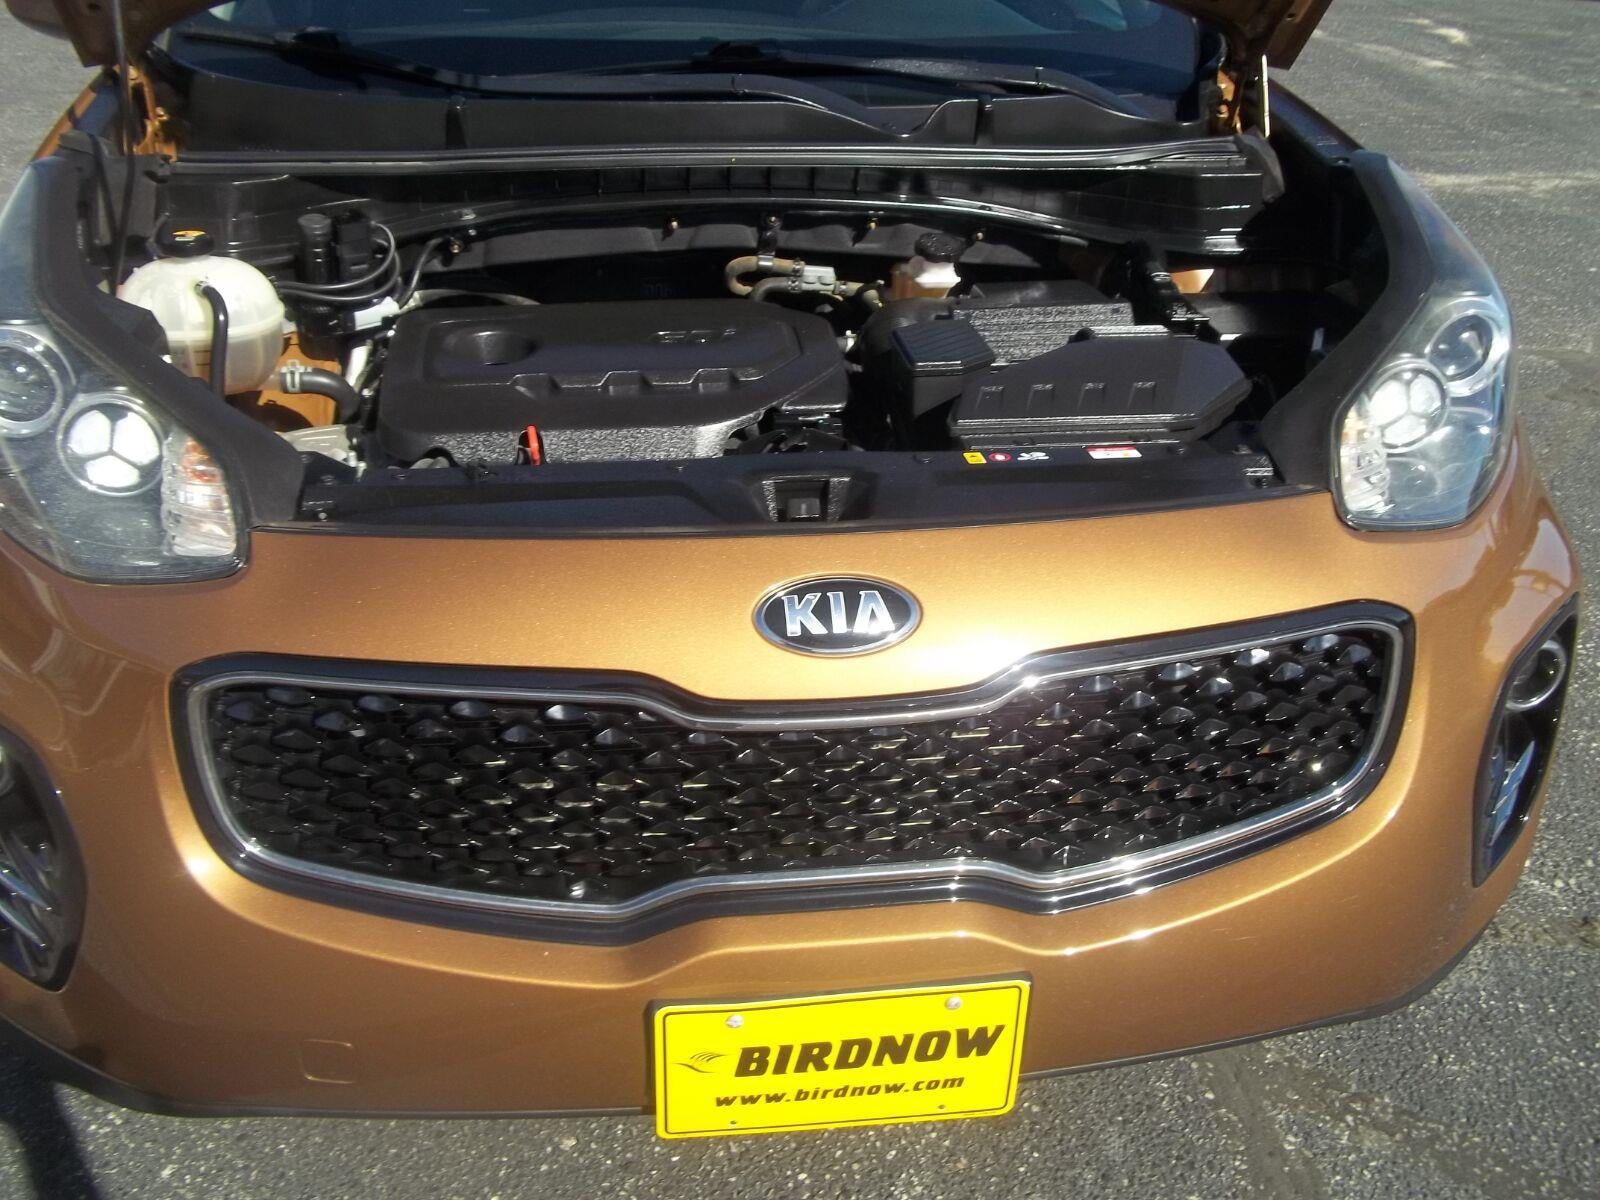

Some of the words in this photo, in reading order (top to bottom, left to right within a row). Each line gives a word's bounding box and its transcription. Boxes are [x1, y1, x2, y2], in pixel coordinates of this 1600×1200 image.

[781, 590, 896, 637] KIA
[734, 1024, 1006, 1078] BIRDNOW
[715, 1076, 965, 1107] www.birdnow.com
